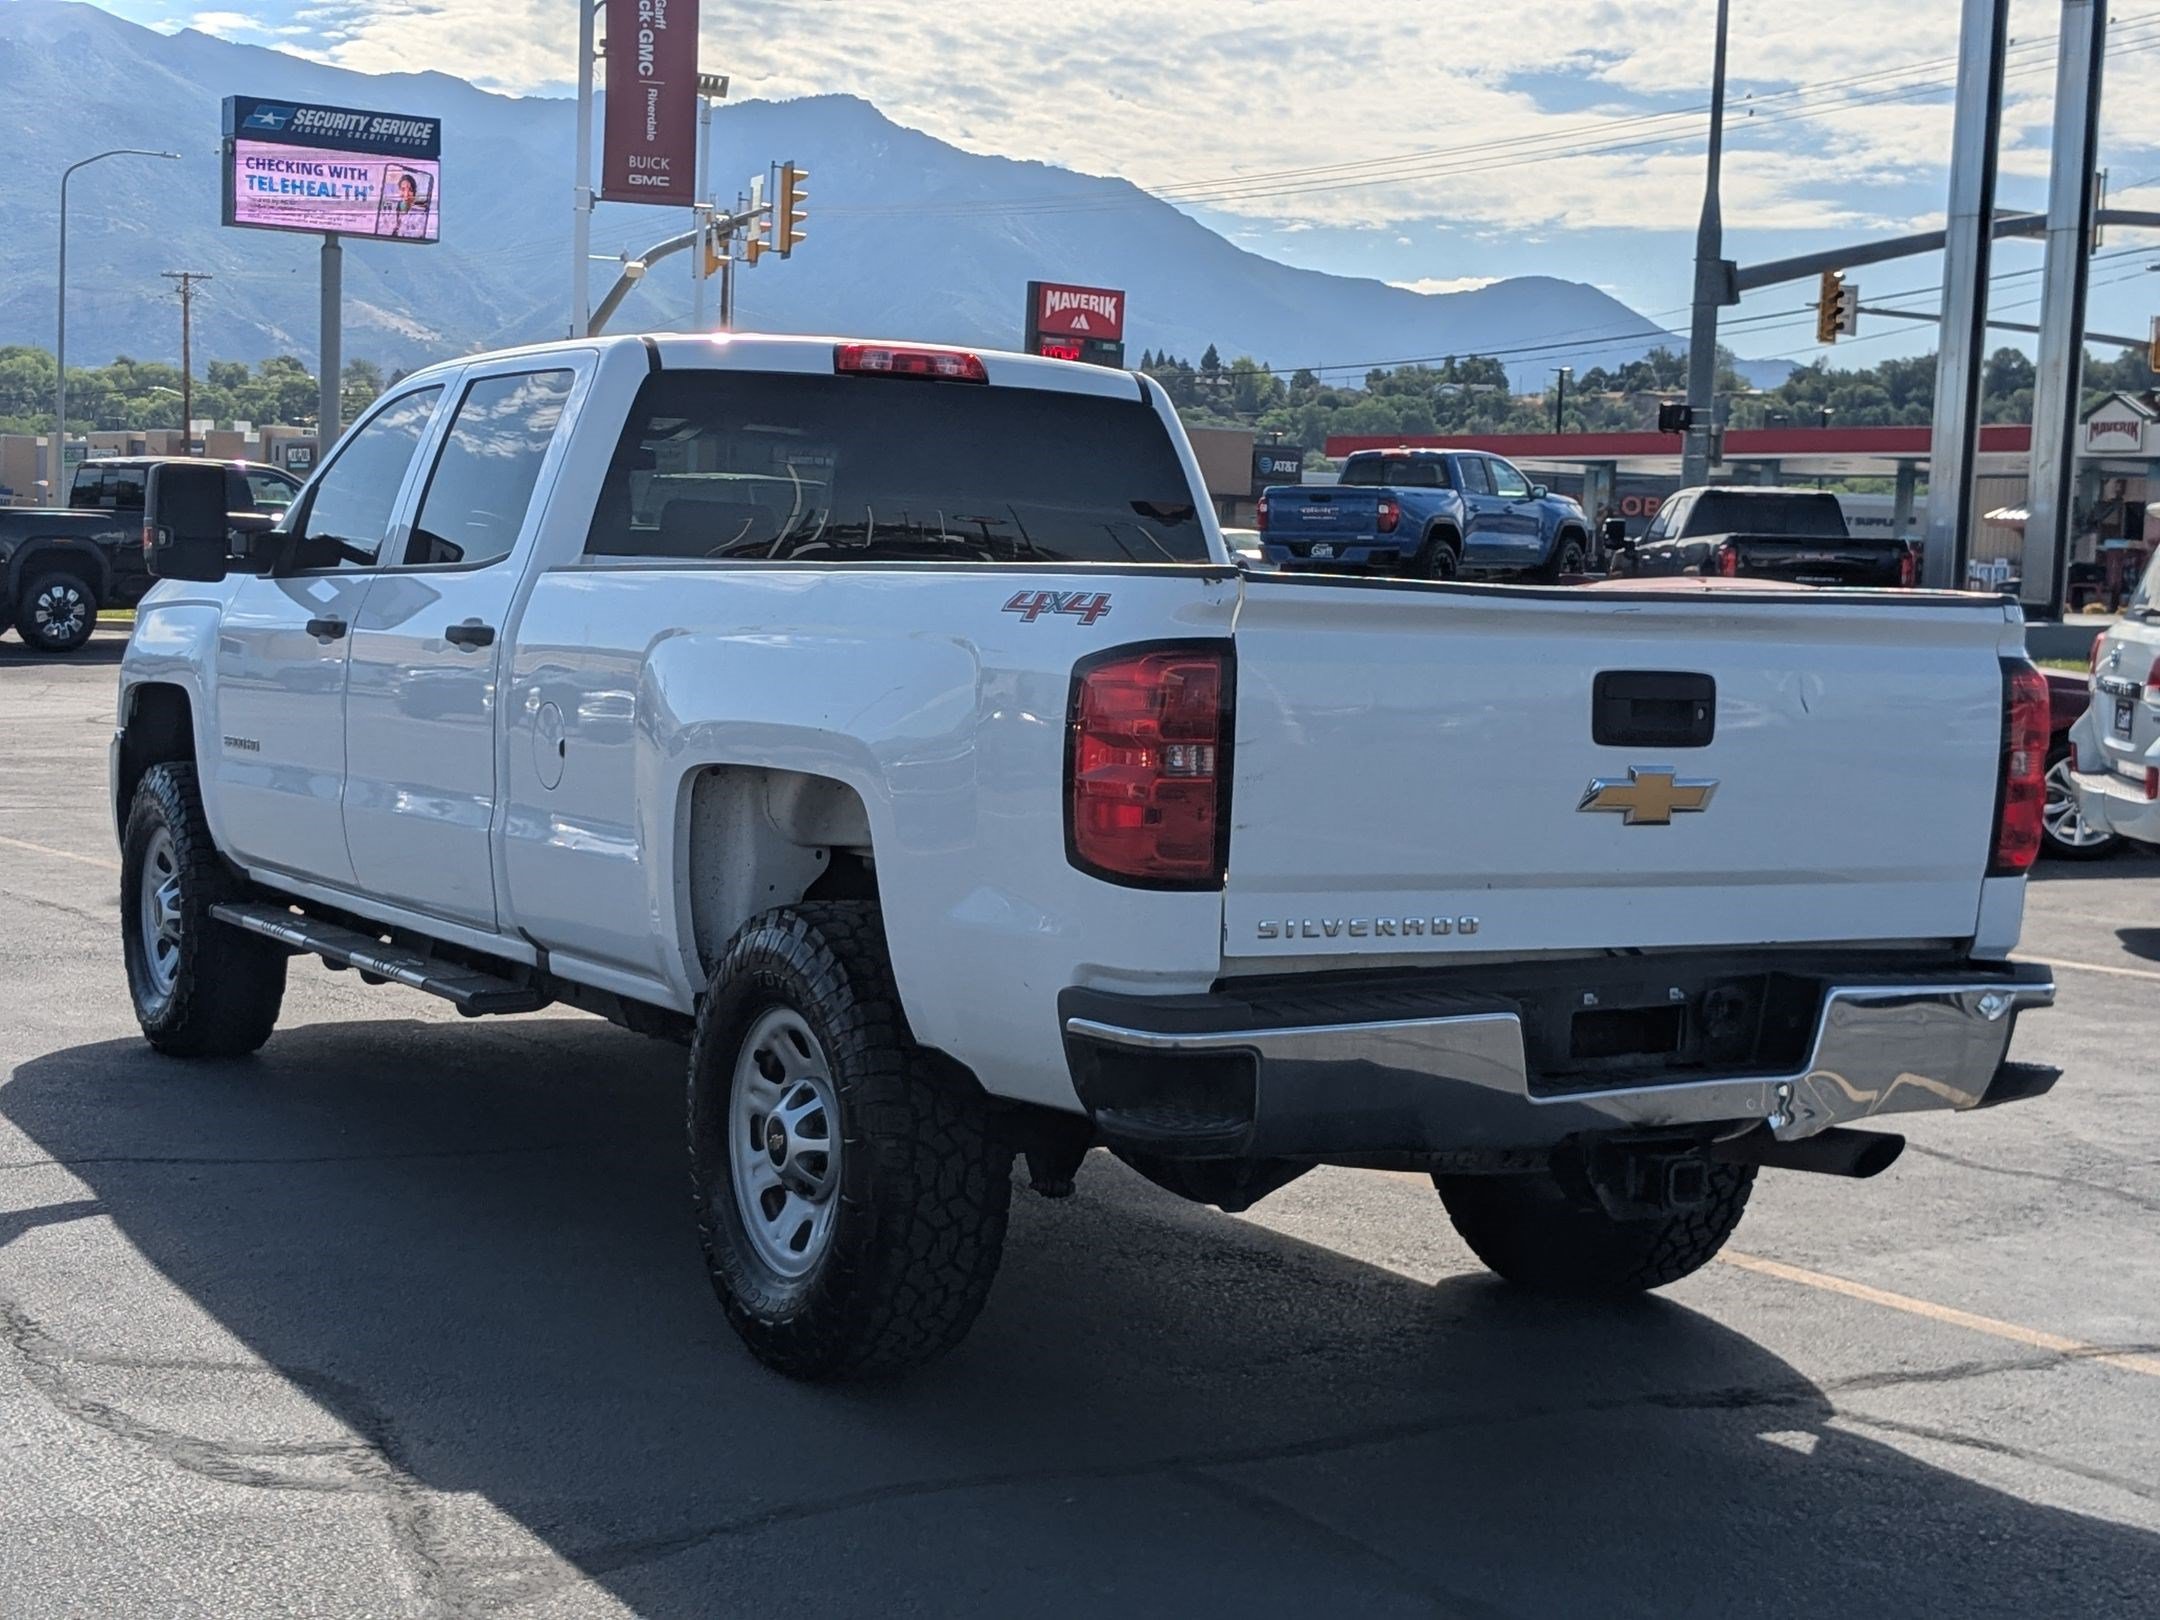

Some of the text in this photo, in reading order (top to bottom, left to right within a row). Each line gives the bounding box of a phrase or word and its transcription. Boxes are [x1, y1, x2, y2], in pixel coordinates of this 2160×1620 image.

[654, 0, 668, 29] Garff
[294, 108, 434, 139] SECURITY SERVICE
[646, 88, 658, 141] Riverdale
[290, 125, 429, 146] FEDERAL CREDIT UNION
[245, 157, 368, 181] CHECKING WITH
[628, 155, 671, 171] BUICK
[628, 174, 671, 187] GMC
[1045, 289, 1118, 326] MAVERIK
[2089, 420, 2139, 443] MAVERIK
[1272, 460, 1299, 473] AT&T
[1256, 915, 1481, 939] SILVERADO
